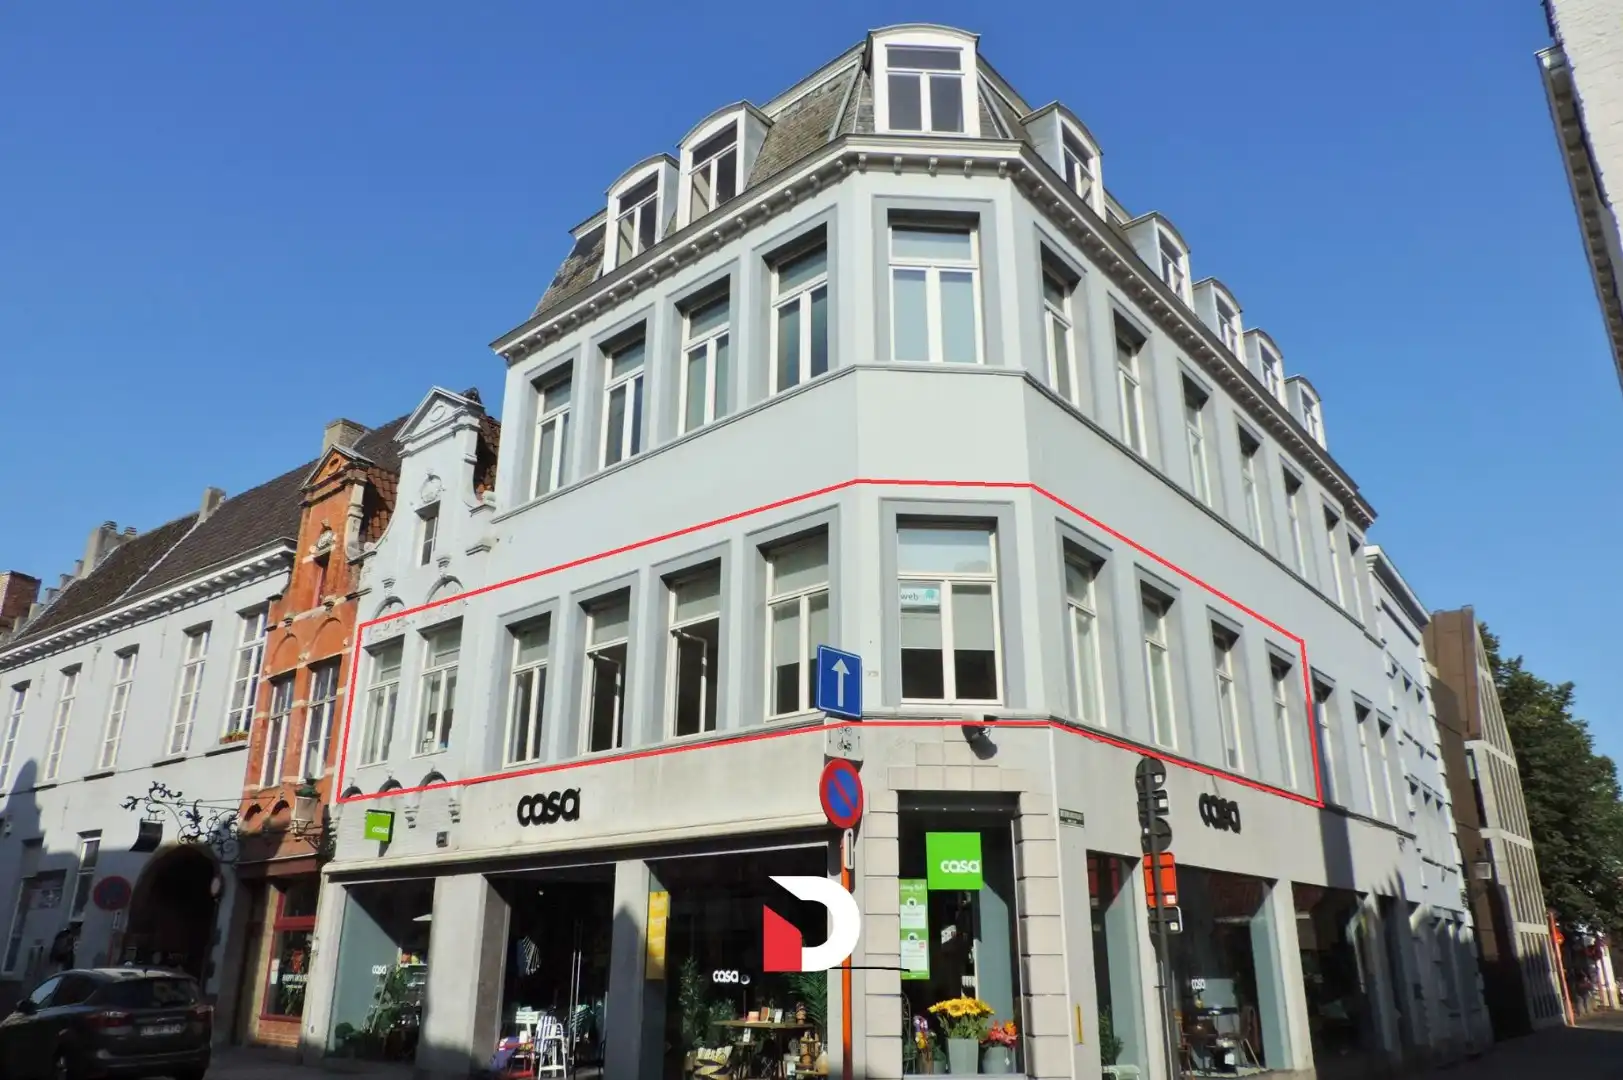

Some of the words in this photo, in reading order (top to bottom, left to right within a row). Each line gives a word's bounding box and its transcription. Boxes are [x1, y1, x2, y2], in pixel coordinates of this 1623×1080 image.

[517, 787, 581, 827] casa
[1199, 793, 1241, 834] casa
[940, 860, 980, 873] casa
[713, 970, 739, 983] casa
